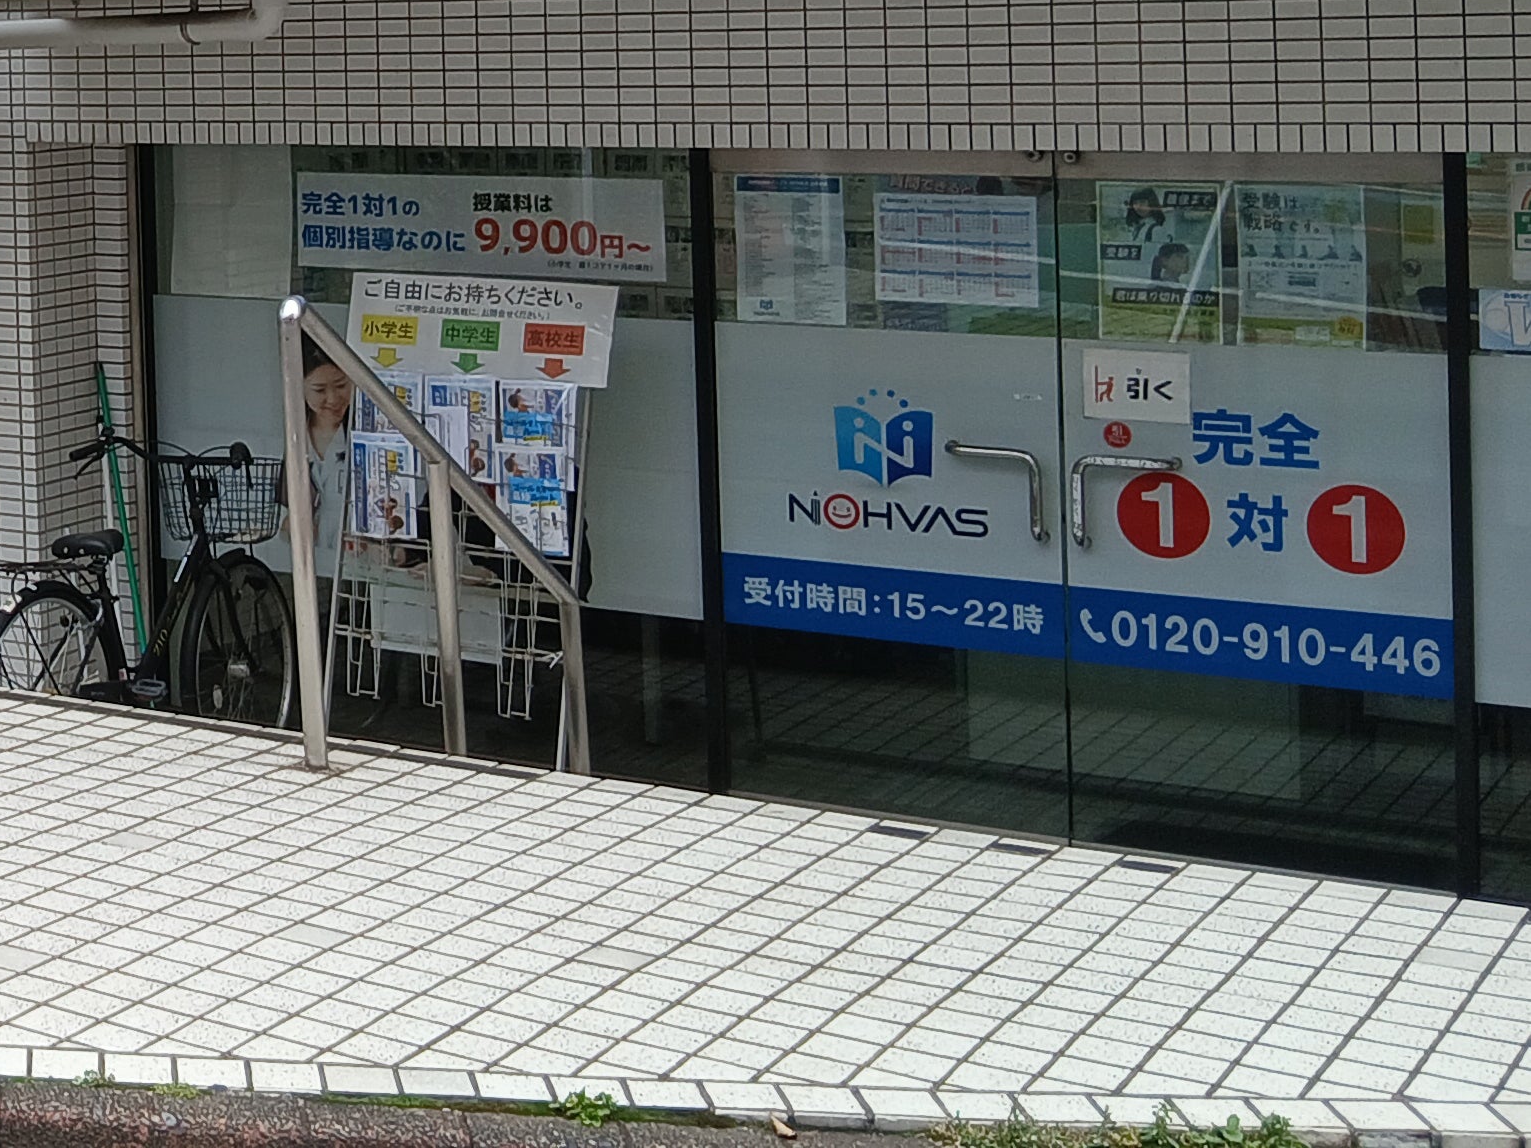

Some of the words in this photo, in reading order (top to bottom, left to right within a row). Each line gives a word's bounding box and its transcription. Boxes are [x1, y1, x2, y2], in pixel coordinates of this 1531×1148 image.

[302, 191, 420, 217] 完全1対1の
[473, 192, 553, 213] 授業料は
[302, 224, 466, 252] 個別指導なのに
[364, 279, 583, 310] ご自由にお持ちください。
[364, 320, 413, 340] 小学生
[445, 325, 497, 344] 中学生
[527, 330, 580, 348] 高校生
[1126, 377, 1174, 401] 引く
[1192, 408, 1321, 470] 完全
[788, 490, 989, 539] NOHVAS
[1110, 608, 1443, 680] 0120-910-446
